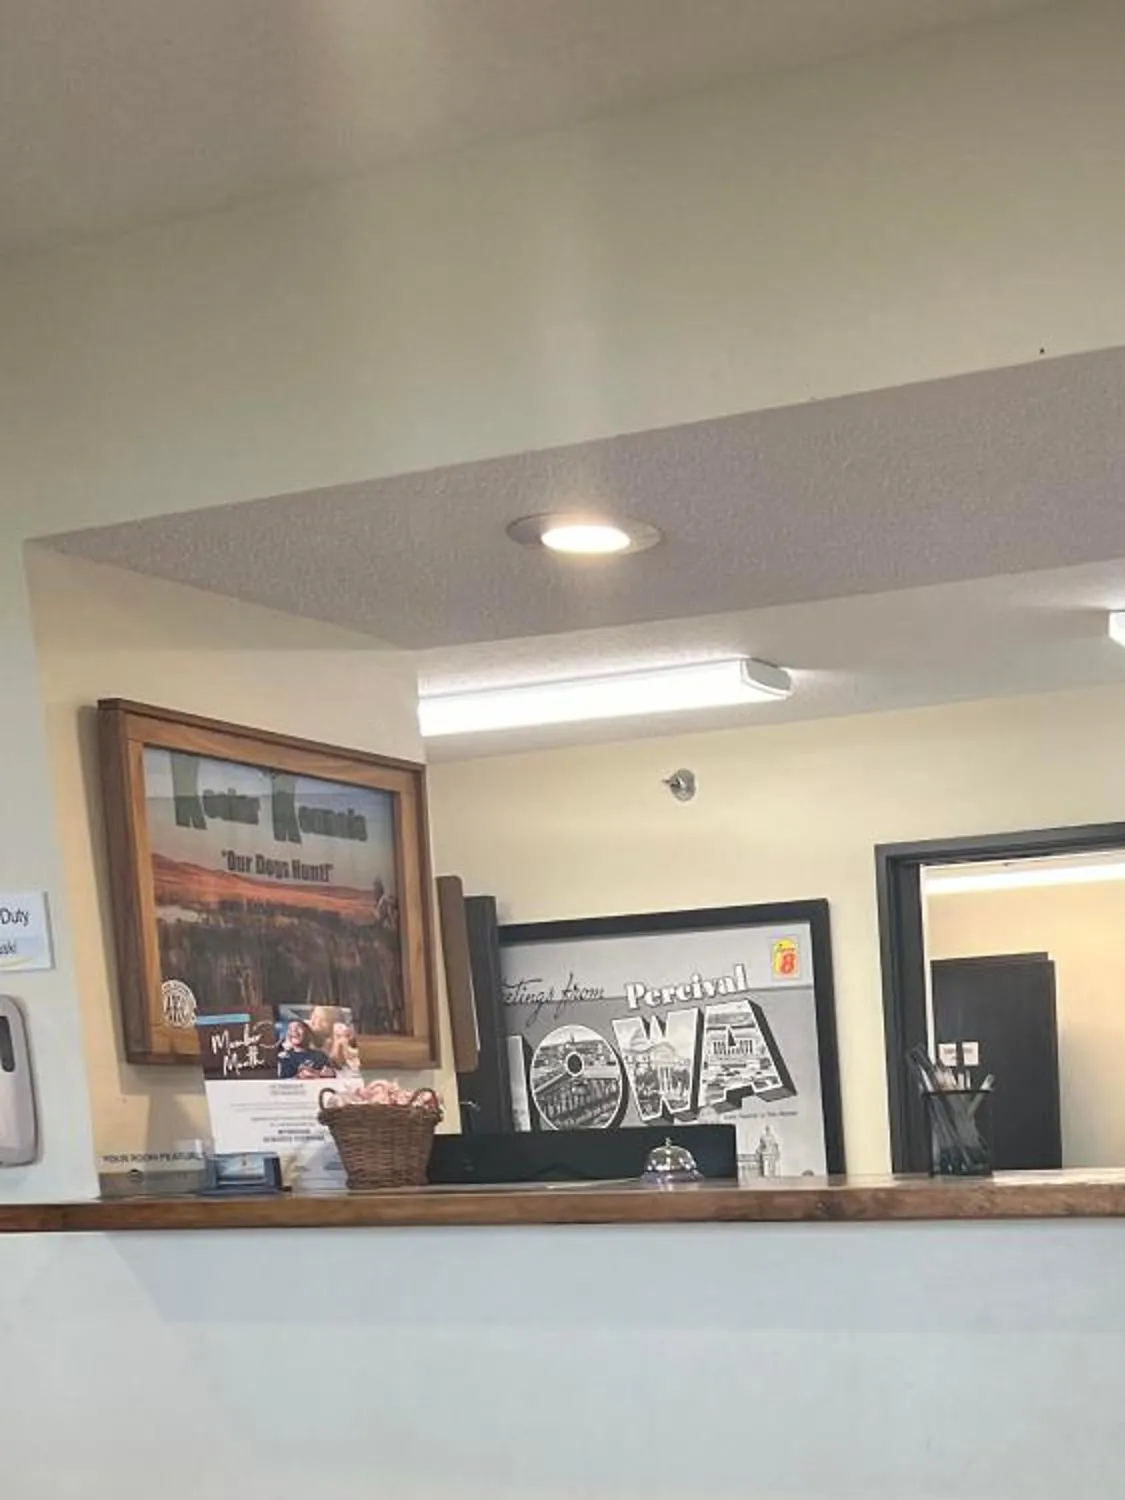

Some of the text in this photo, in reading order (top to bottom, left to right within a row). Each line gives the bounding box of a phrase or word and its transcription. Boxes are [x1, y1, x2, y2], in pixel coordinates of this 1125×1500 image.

[0, 908, 29, 928] Duty
[623, 962, 749, 1010] Percival
[507, 1000, 797, 1130] IOWA
